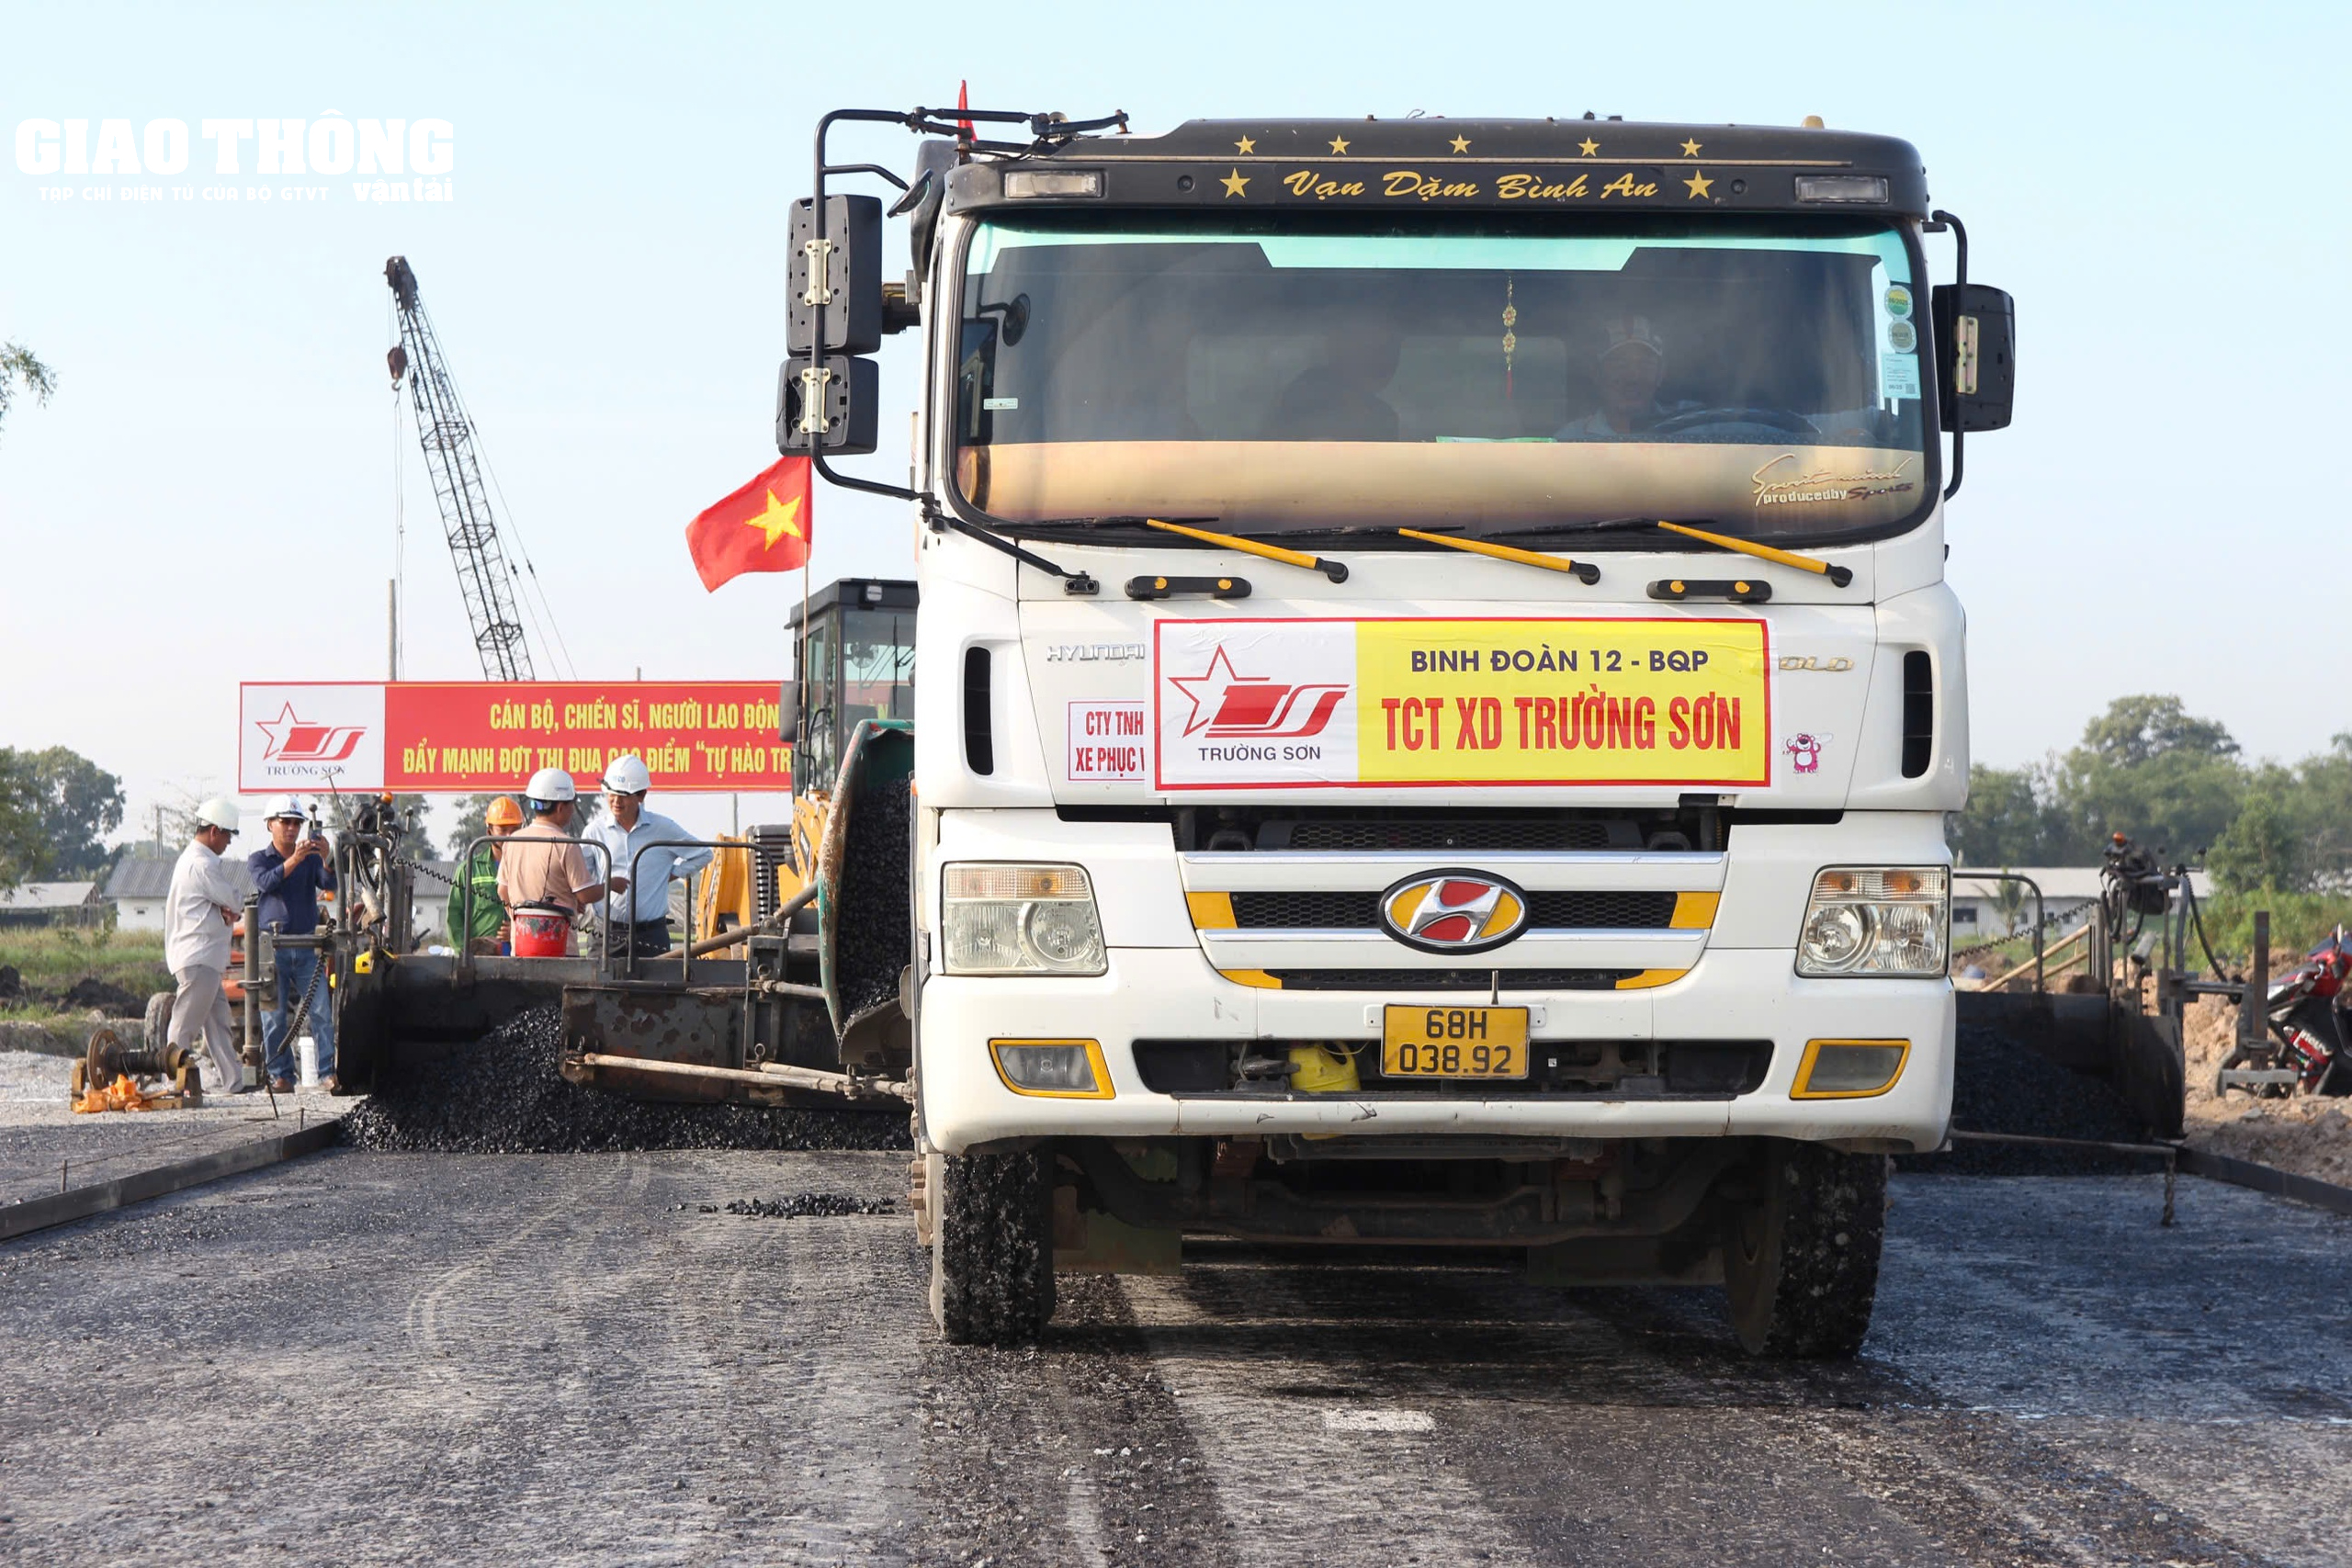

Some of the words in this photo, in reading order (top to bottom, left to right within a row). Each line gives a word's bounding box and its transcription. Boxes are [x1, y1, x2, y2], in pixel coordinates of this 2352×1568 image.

[1283, 170, 1364, 200] Vạn
[1382, 170, 1477, 202] Dặm
[1497, 174, 1589, 199] Bình
[1602, 173, 1657, 198] An
[1046, 644, 1146, 661] HYUNDAI
[1411, 650, 1479, 672] BINH
[1489, 643, 1577, 672] ĐOÀN
[1589, 649, 1622, 671] 12
[1649, 649, 1709, 673] BQP
[1778, 655, 1855, 672] OLD
[490, 698, 526, 730] CÁN
[564, 695, 616, 730] CHIẾN
[649, 697, 702, 730] NGƯỜI
[707, 703, 740, 730] LAO
[743, 697, 780, 735] ĐỘN
[1086, 711, 1112, 736] CTY
[1115, 711, 1145, 736] TNH
[1381, 696, 1444, 751] TCT
[1455, 697, 1502, 750] XD
[1514, 683, 1656, 750] TRƯỜNG
[1668, 691, 1741, 750] SƠN
[402, 737, 438, 773] ĐẨY
[442, 747, 495, 779] MẠNH
[498, 745, 533, 779] ĐỢT
[536, 747, 565, 773] THI
[568, 747, 603, 773] ĐUA
[645, 737, 691, 773] ĐIỂM
[730, 741, 766, 773] HÀO
[770, 747, 792, 773] TR
[1075, 747, 1094, 772] XE
[1097, 747, 1136, 777] PHỤC
[1197, 744, 1277, 761] TRƯỜNG
[1283, 744, 1322, 761] SƠN
[266, 762, 319, 776] TRƯỜNG
[1426, 1010, 1487, 1040] 68H
[1399, 1043, 1511, 1074] 038.92
